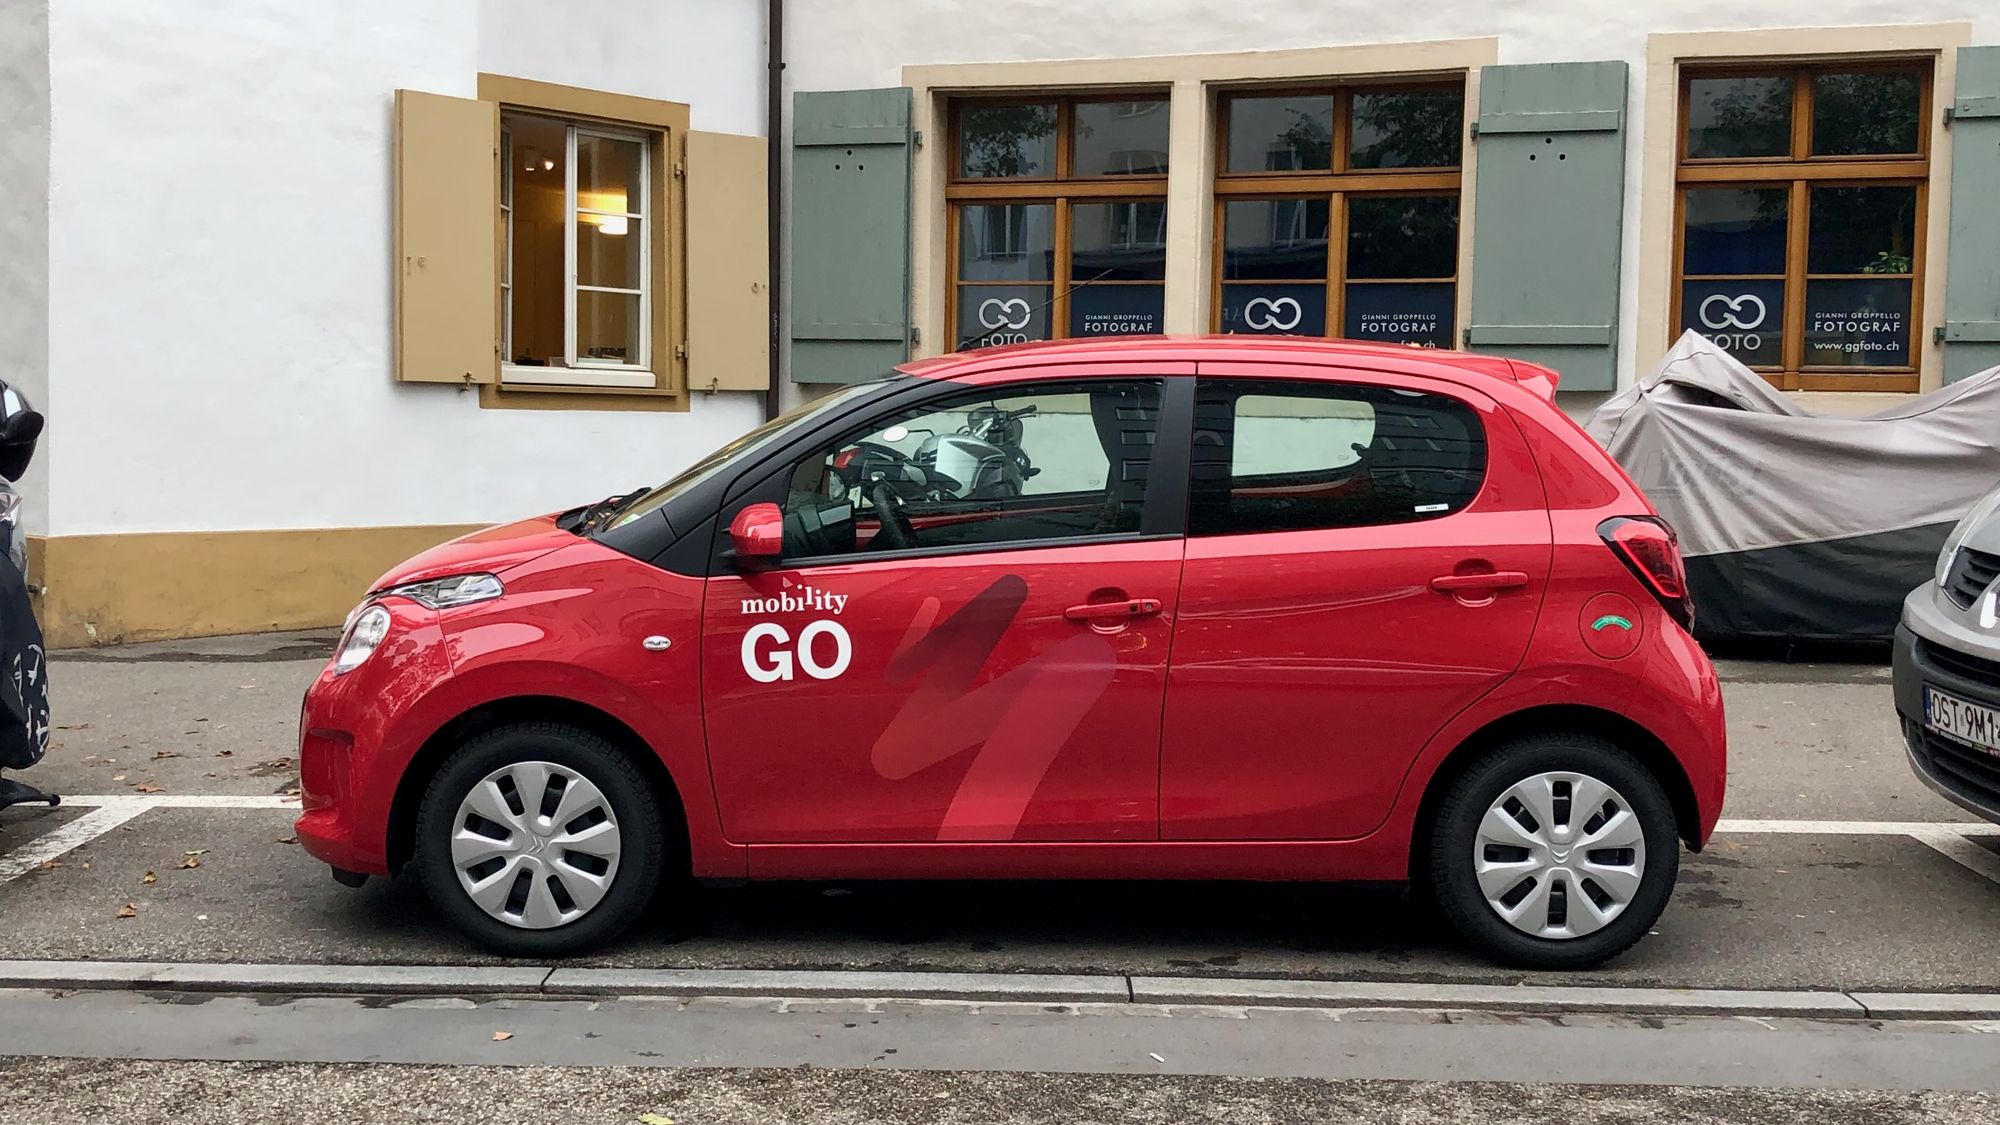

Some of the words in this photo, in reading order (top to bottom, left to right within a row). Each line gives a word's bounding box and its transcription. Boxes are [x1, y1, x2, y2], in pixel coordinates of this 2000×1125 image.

[1084, 322, 1153, 332] FOTOGRAF
[1361, 322, 1437, 333] FOTOGRAF
[1814, 321, 1901, 332] FOTOGRAF
[1814, 340, 1900, 353] www.ggfoto.ch
[741, 584, 848, 615] mobility
[741, 619, 852, 683] GO
[1932, 693, 1959, 732] OST
